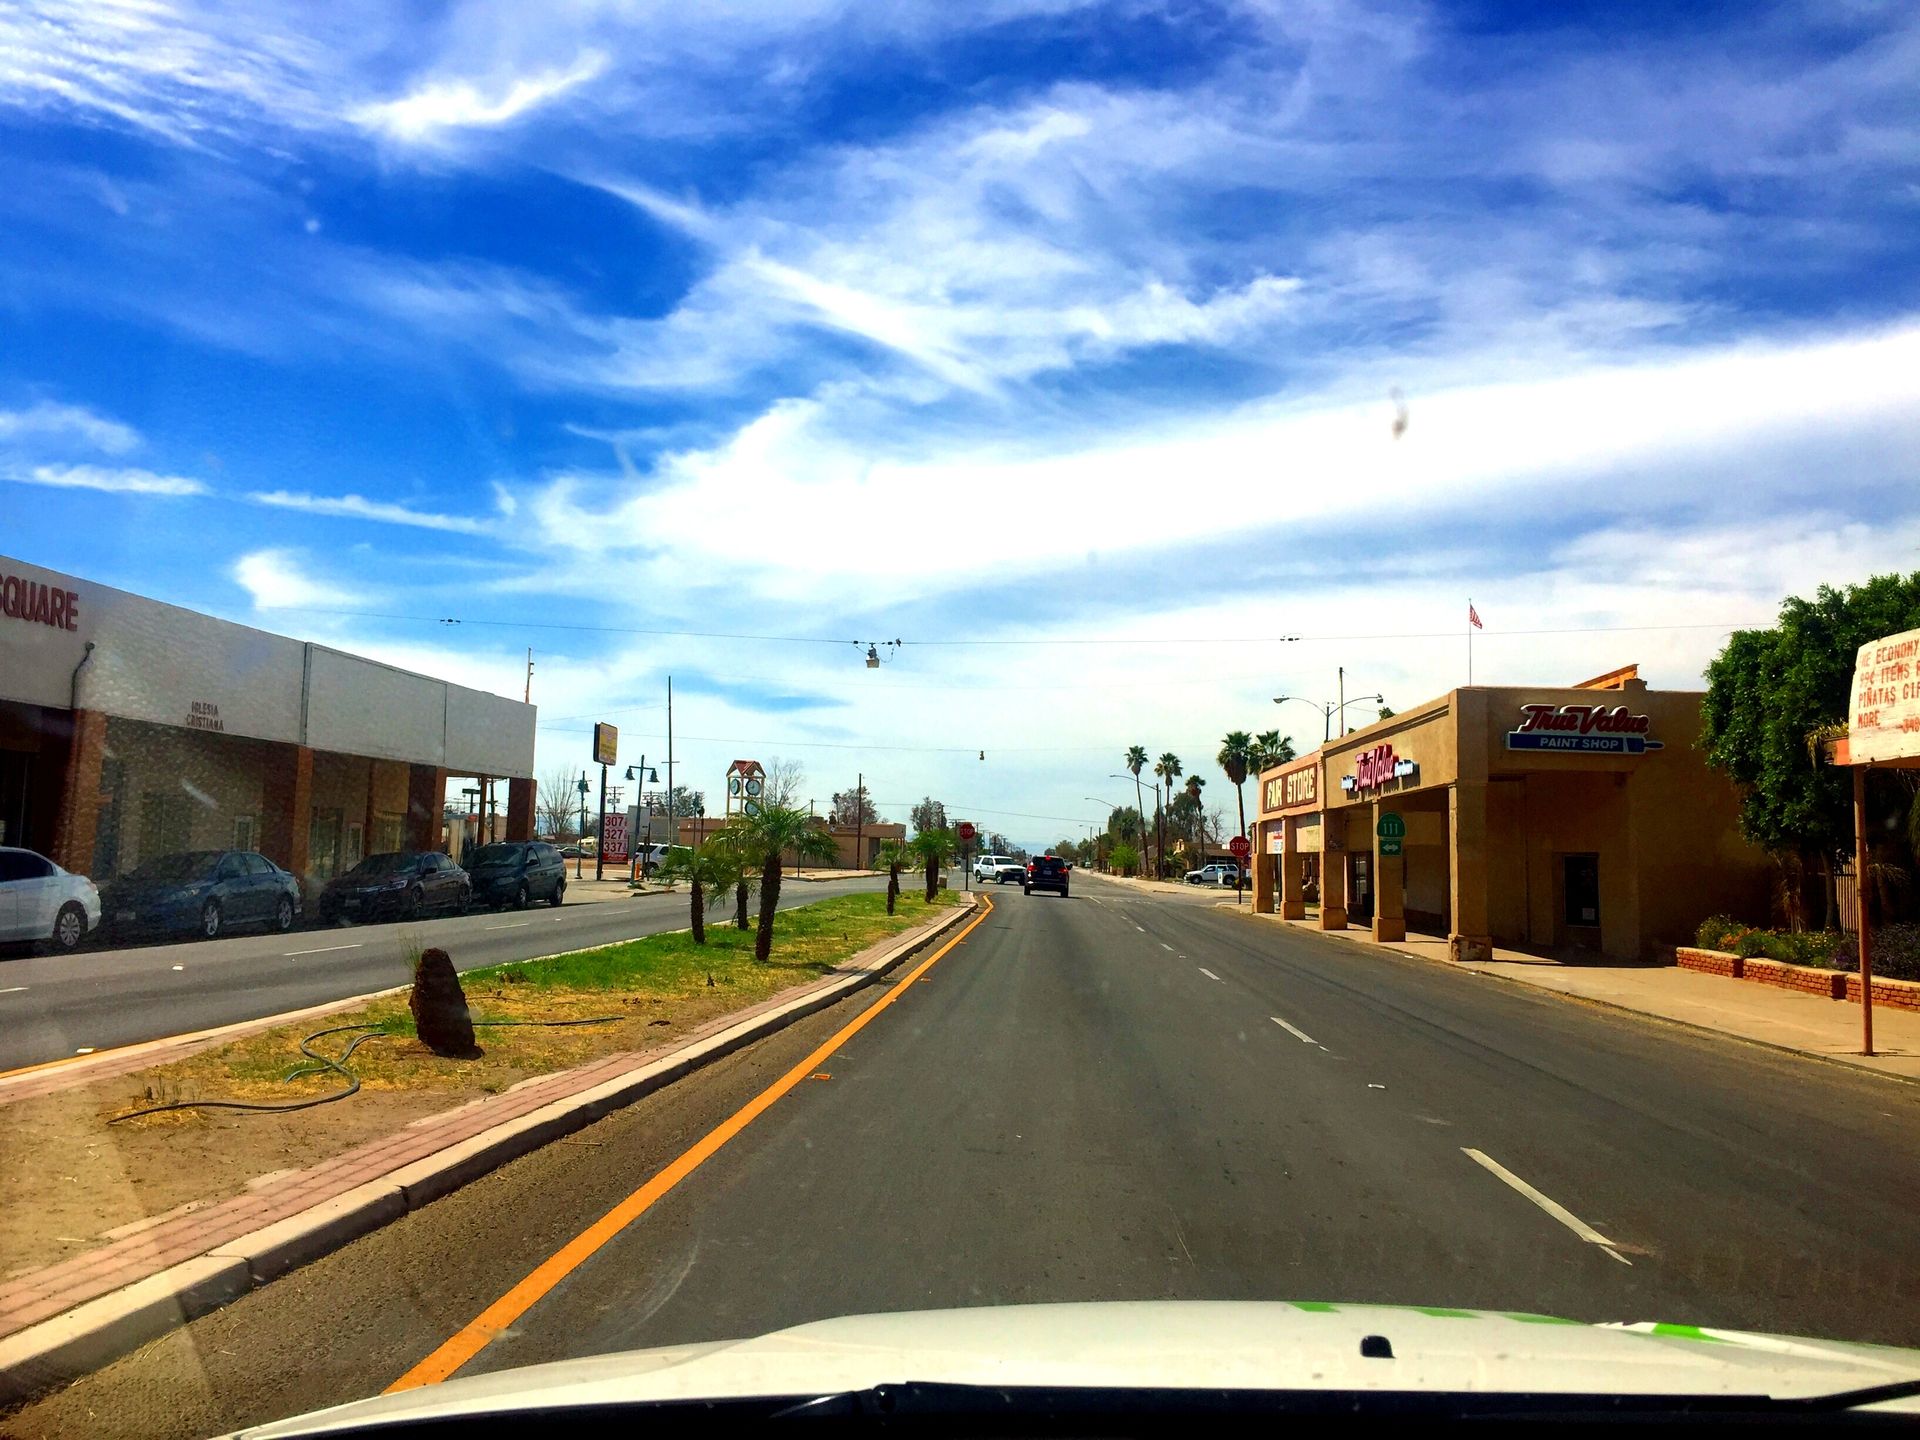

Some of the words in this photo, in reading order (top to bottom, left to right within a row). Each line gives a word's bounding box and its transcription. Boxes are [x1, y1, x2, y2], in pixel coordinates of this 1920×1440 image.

[0, 574, 79, 632] QUARE
[1876, 639, 1920, 664] ECONOMY
[1881, 662, 1910, 683] ITEMS
[1859, 686, 1896, 708] PIÑATAS
[192, 701, 219, 717] IGLESIA
[187, 713, 224, 731] CRISTIANA
[1522, 704, 1578, 732] True
[1562, 705, 1649, 734] Value
[1858, 710, 1881, 728] MORE
[1540, 737, 1578, 748] PAINT
[1581, 739, 1619, 749] SHOP
[1354, 753, 1372, 792] True
[1367, 744, 1395, 789] Value
[1267, 778, 1282, 809] FAIR
[1287, 767, 1315, 803] STORE
[605, 816, 624, 827] 307
[1384, 823, 1398, 835] 111
[604, 829, 623, 839] 327
[604, 841, 623, 852] 337
[1230, 842, 1249, 851] STOP
